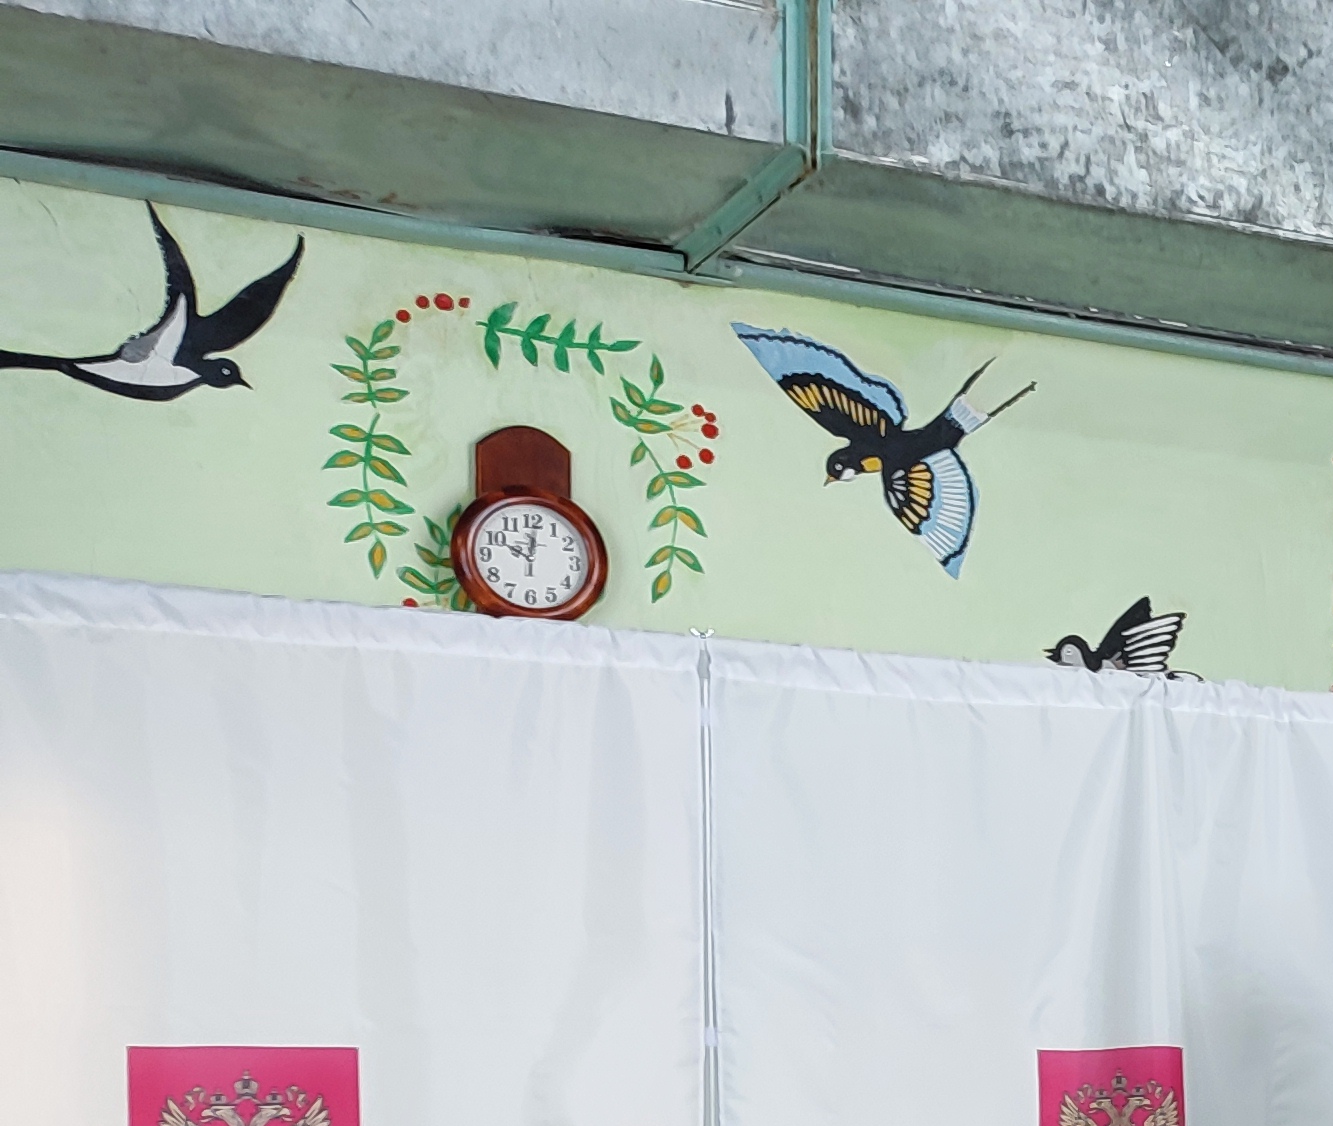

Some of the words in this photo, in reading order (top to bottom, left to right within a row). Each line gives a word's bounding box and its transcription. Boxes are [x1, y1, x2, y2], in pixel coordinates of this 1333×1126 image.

[502, 516, 519, 532] 11
[523, 514, 543, 529] 12
[549, 523, 559, 538] 1
[486, 531, 506, 547] 10
[562, 536, 574, 552] 2
[480, 547, 492, 562] 9
[569, 556, 581, 572] 3
[487, 567, 500, 582] 8
[560, 575, 571, 590] 4
[504, 583, 517, 598] 7
[525, 589, 537, 605] 6
[545, 587, 557, 603] 5
